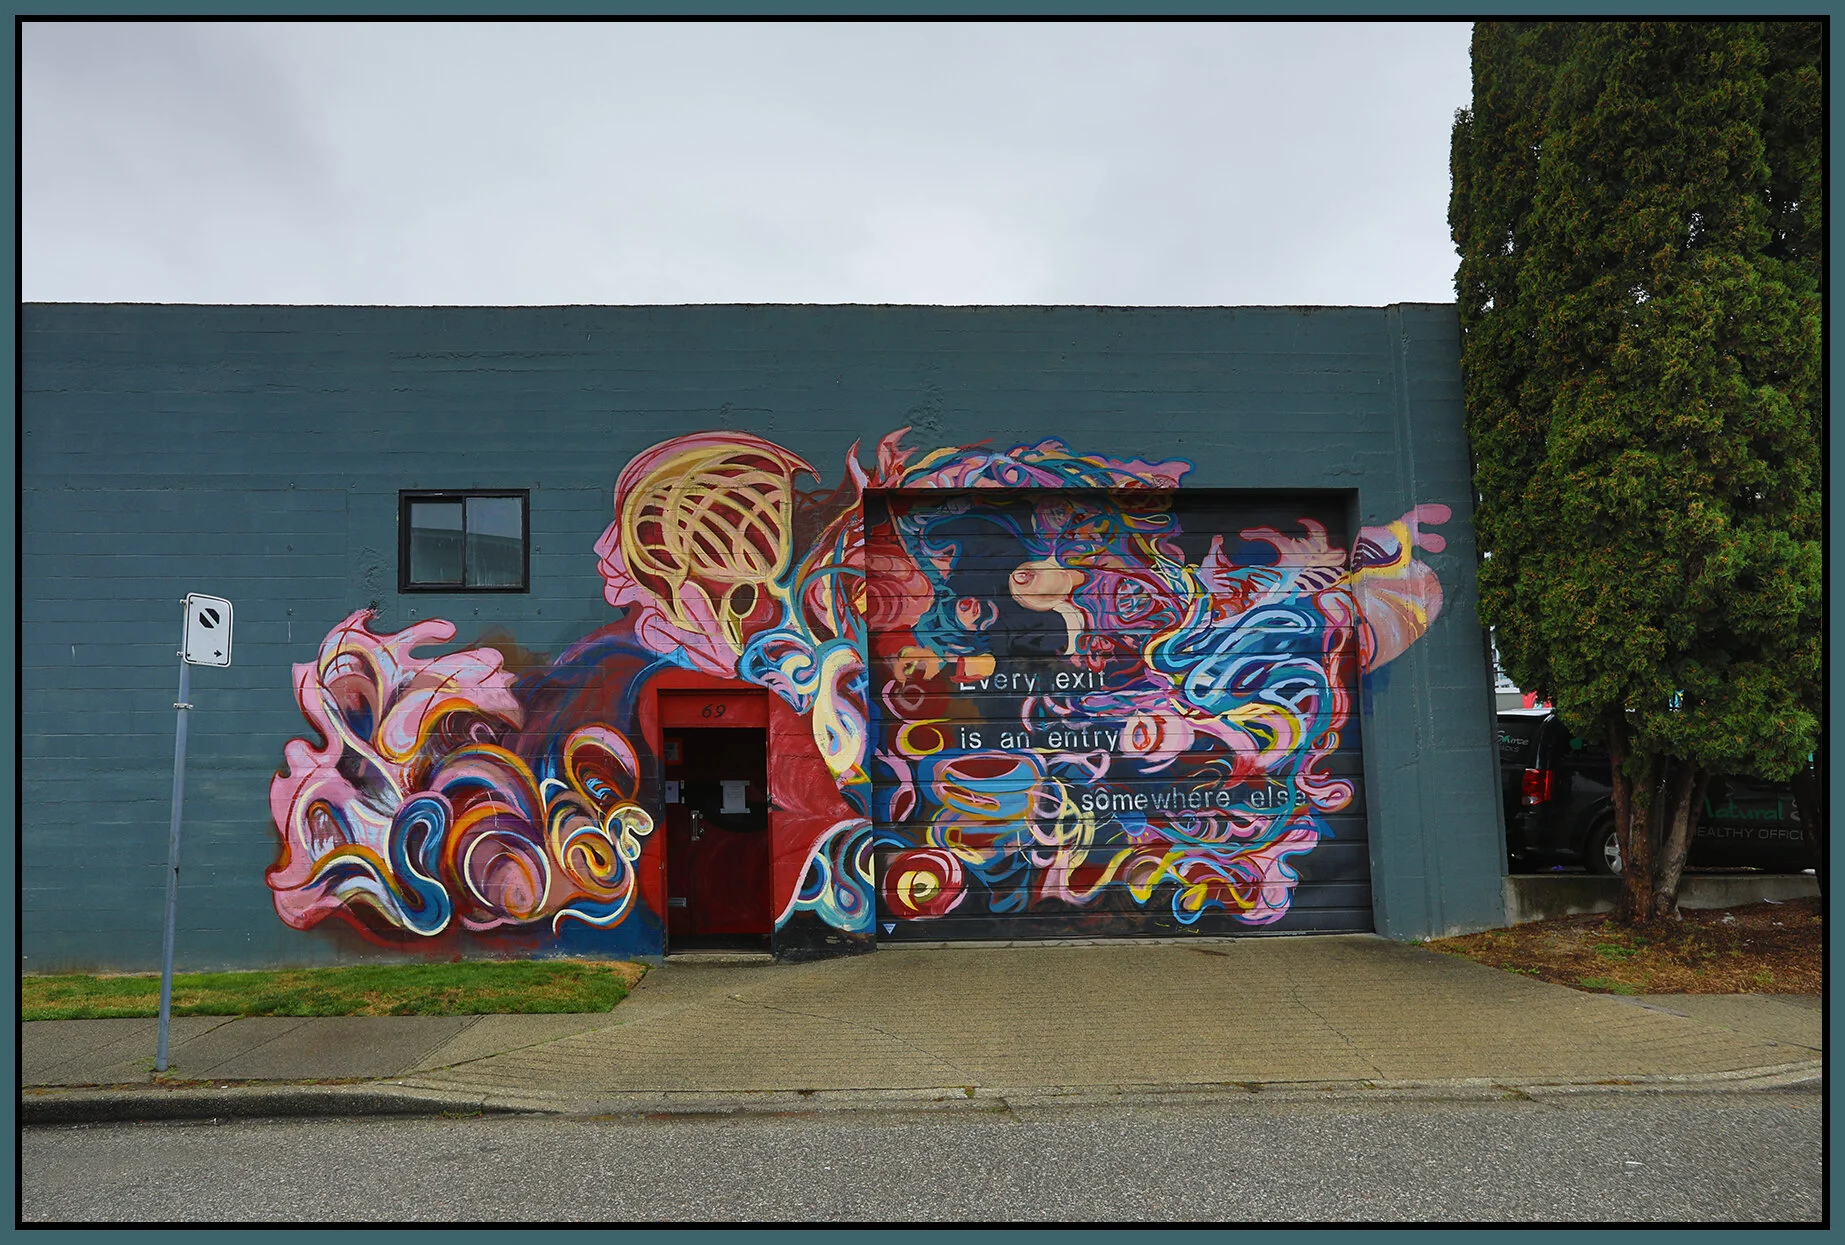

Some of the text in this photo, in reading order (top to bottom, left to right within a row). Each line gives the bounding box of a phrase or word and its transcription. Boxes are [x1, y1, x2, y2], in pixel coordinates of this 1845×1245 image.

[1056, 668, 1105, 690] exit
[702, 703, 726, 718] 69
[961, 727, 1118, 752] is an entry
[1082, 786, 1306, 811] somewhere else
[1695, 826, 1754, 840] EALTHY
